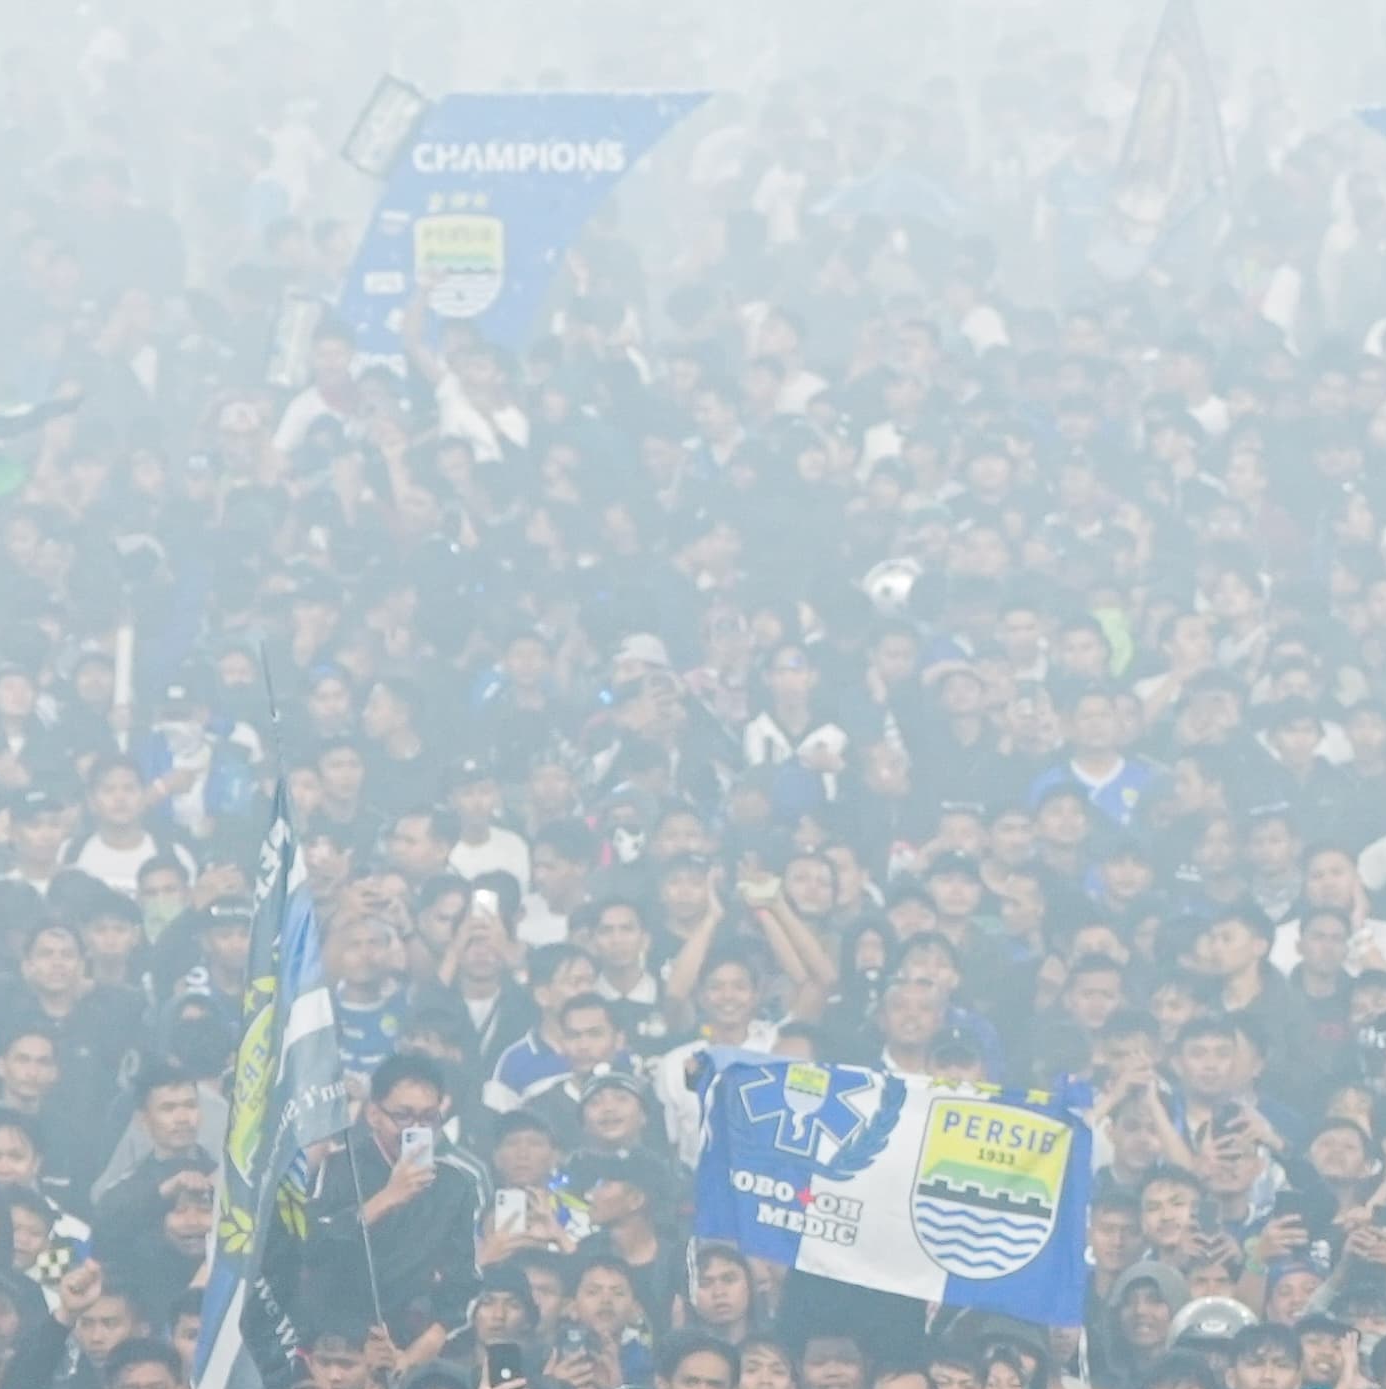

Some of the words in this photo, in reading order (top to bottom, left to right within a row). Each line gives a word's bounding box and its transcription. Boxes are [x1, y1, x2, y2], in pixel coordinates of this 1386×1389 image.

[413, 142, 626, 173] CHAMPIONS
[942, 1109, 1058, 1155] PERSIB
[976, 1147, 1016, 1166] 1933
[756, 1200, 857, 1246] MEDIC
